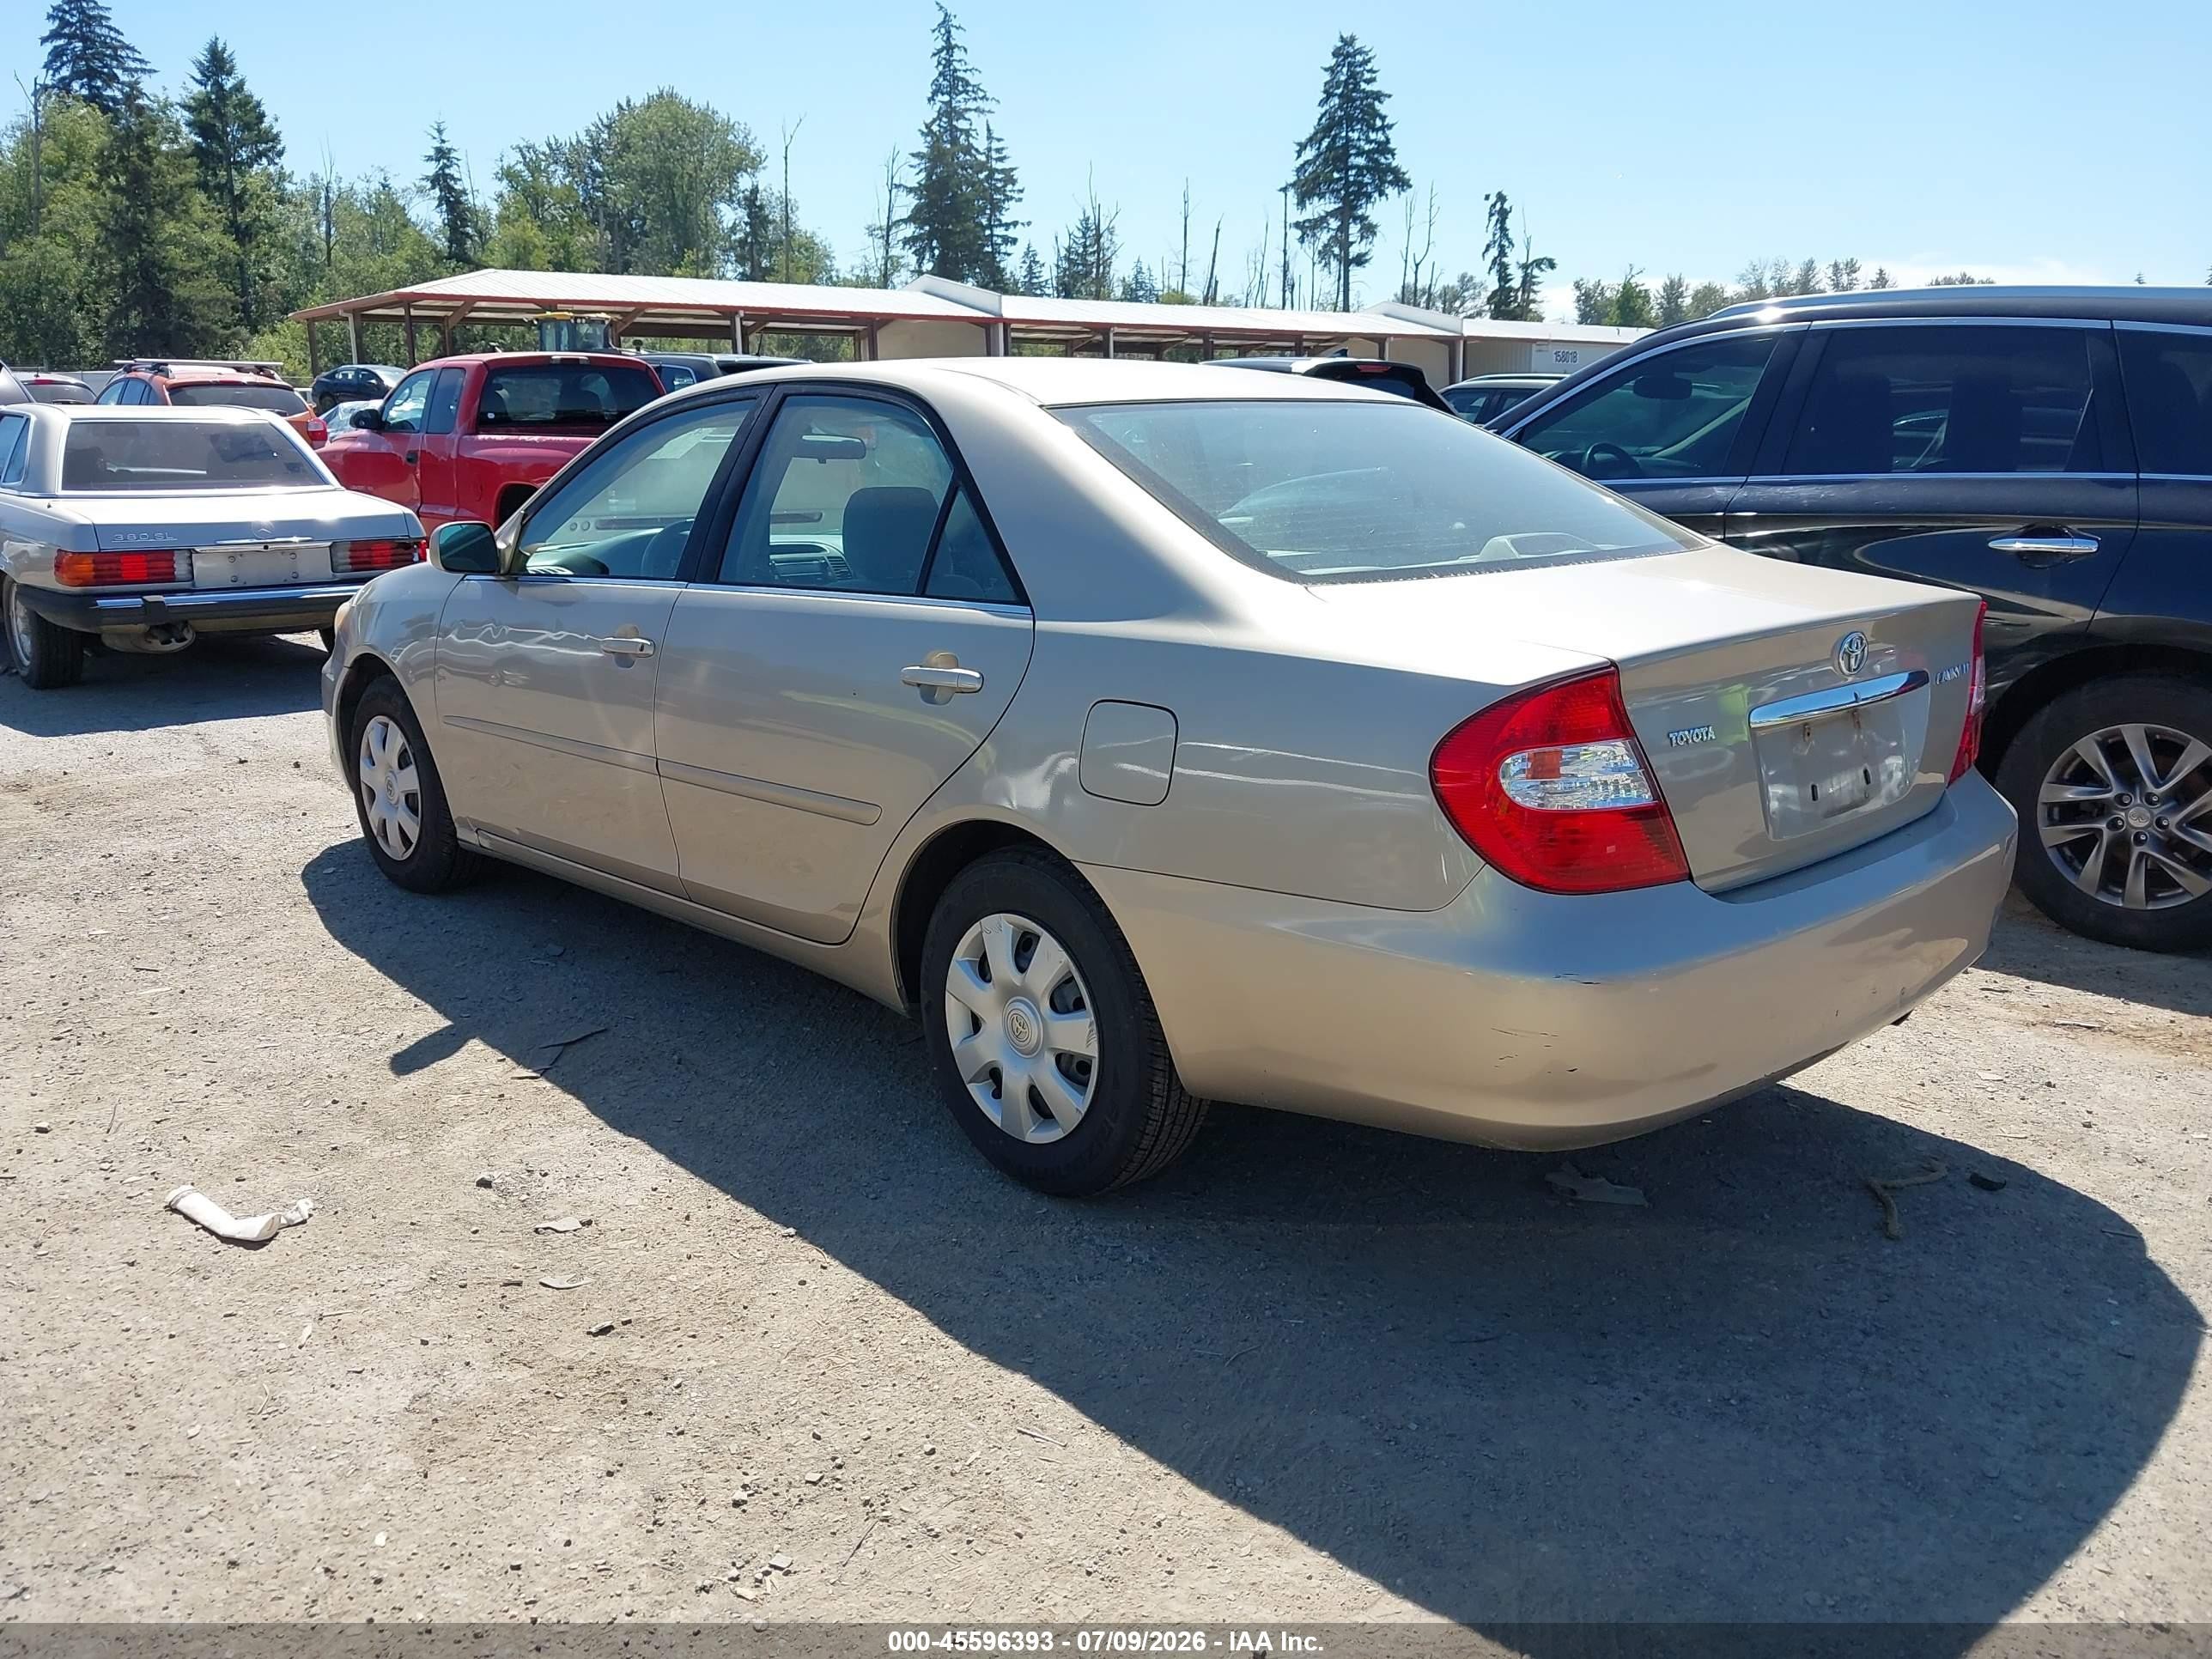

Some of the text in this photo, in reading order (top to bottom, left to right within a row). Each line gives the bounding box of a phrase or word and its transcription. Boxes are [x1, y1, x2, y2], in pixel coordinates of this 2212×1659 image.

[114, 532, 173, 541] 380 SL
[1668, 726, 1716, 747] TOYOTA
